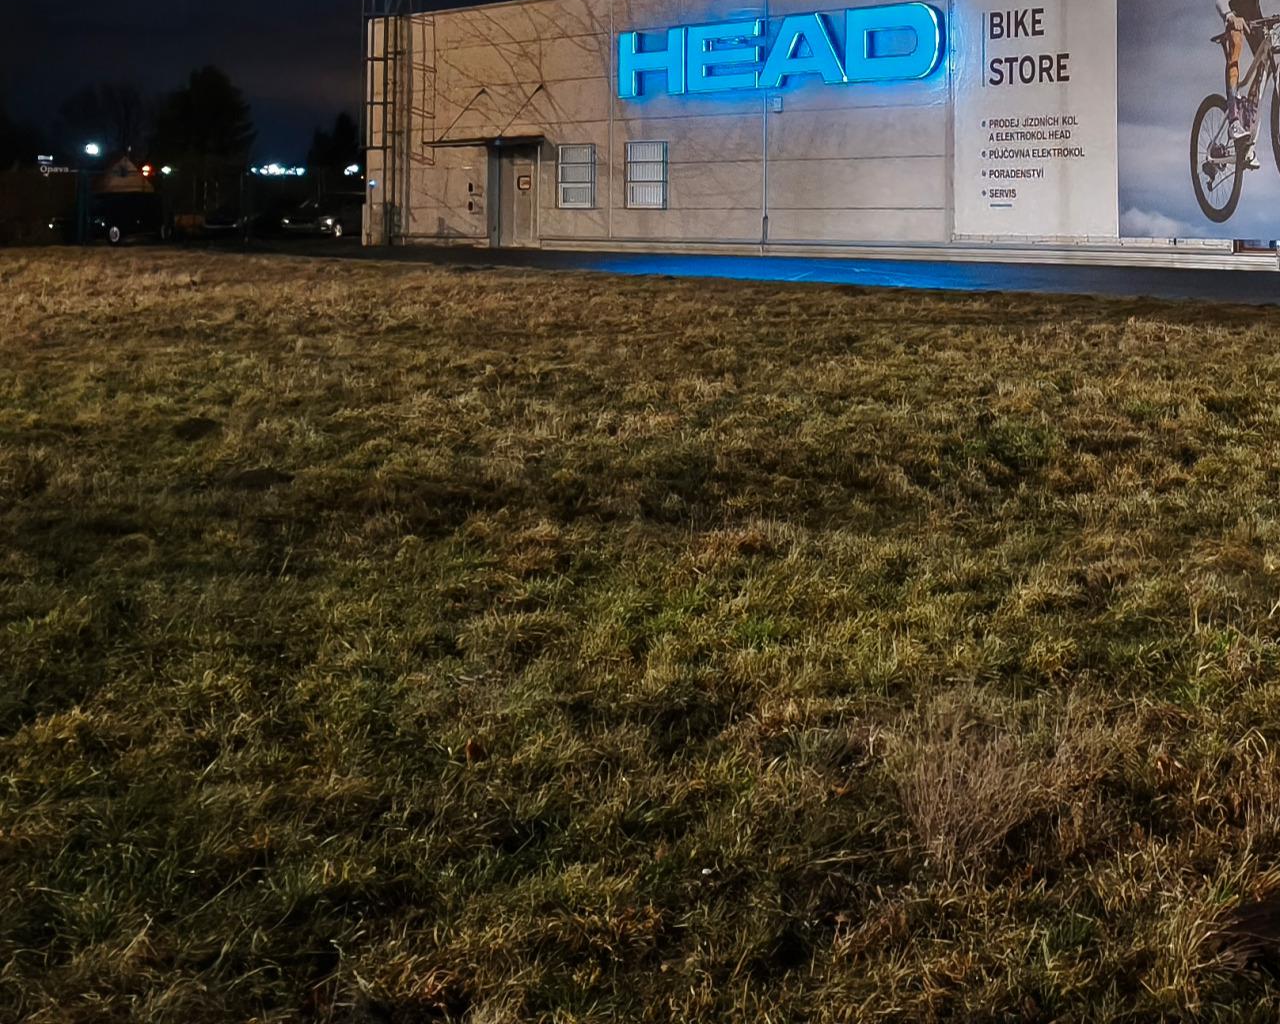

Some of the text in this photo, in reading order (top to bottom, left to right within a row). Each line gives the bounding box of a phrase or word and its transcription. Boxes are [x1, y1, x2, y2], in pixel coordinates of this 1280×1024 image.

[989, 8, 1045, 40] BIKE
[617, 1, 948, 100] HEAD
[988, 53, 1070, 86] STORE
[989, 118, 1019, 129] PRODEJ
[1062, 116, 1078, 126] KOL
[989, 129, 1071, 142] A ELEKTROKOL HEAD
[989, 147, 1085, 159] PŮJČOVNA ELEKTROKOL
[989, 168, 1044, 178] PORADENSTVÍ
[989, 188, 1017, 198] SERVIS
